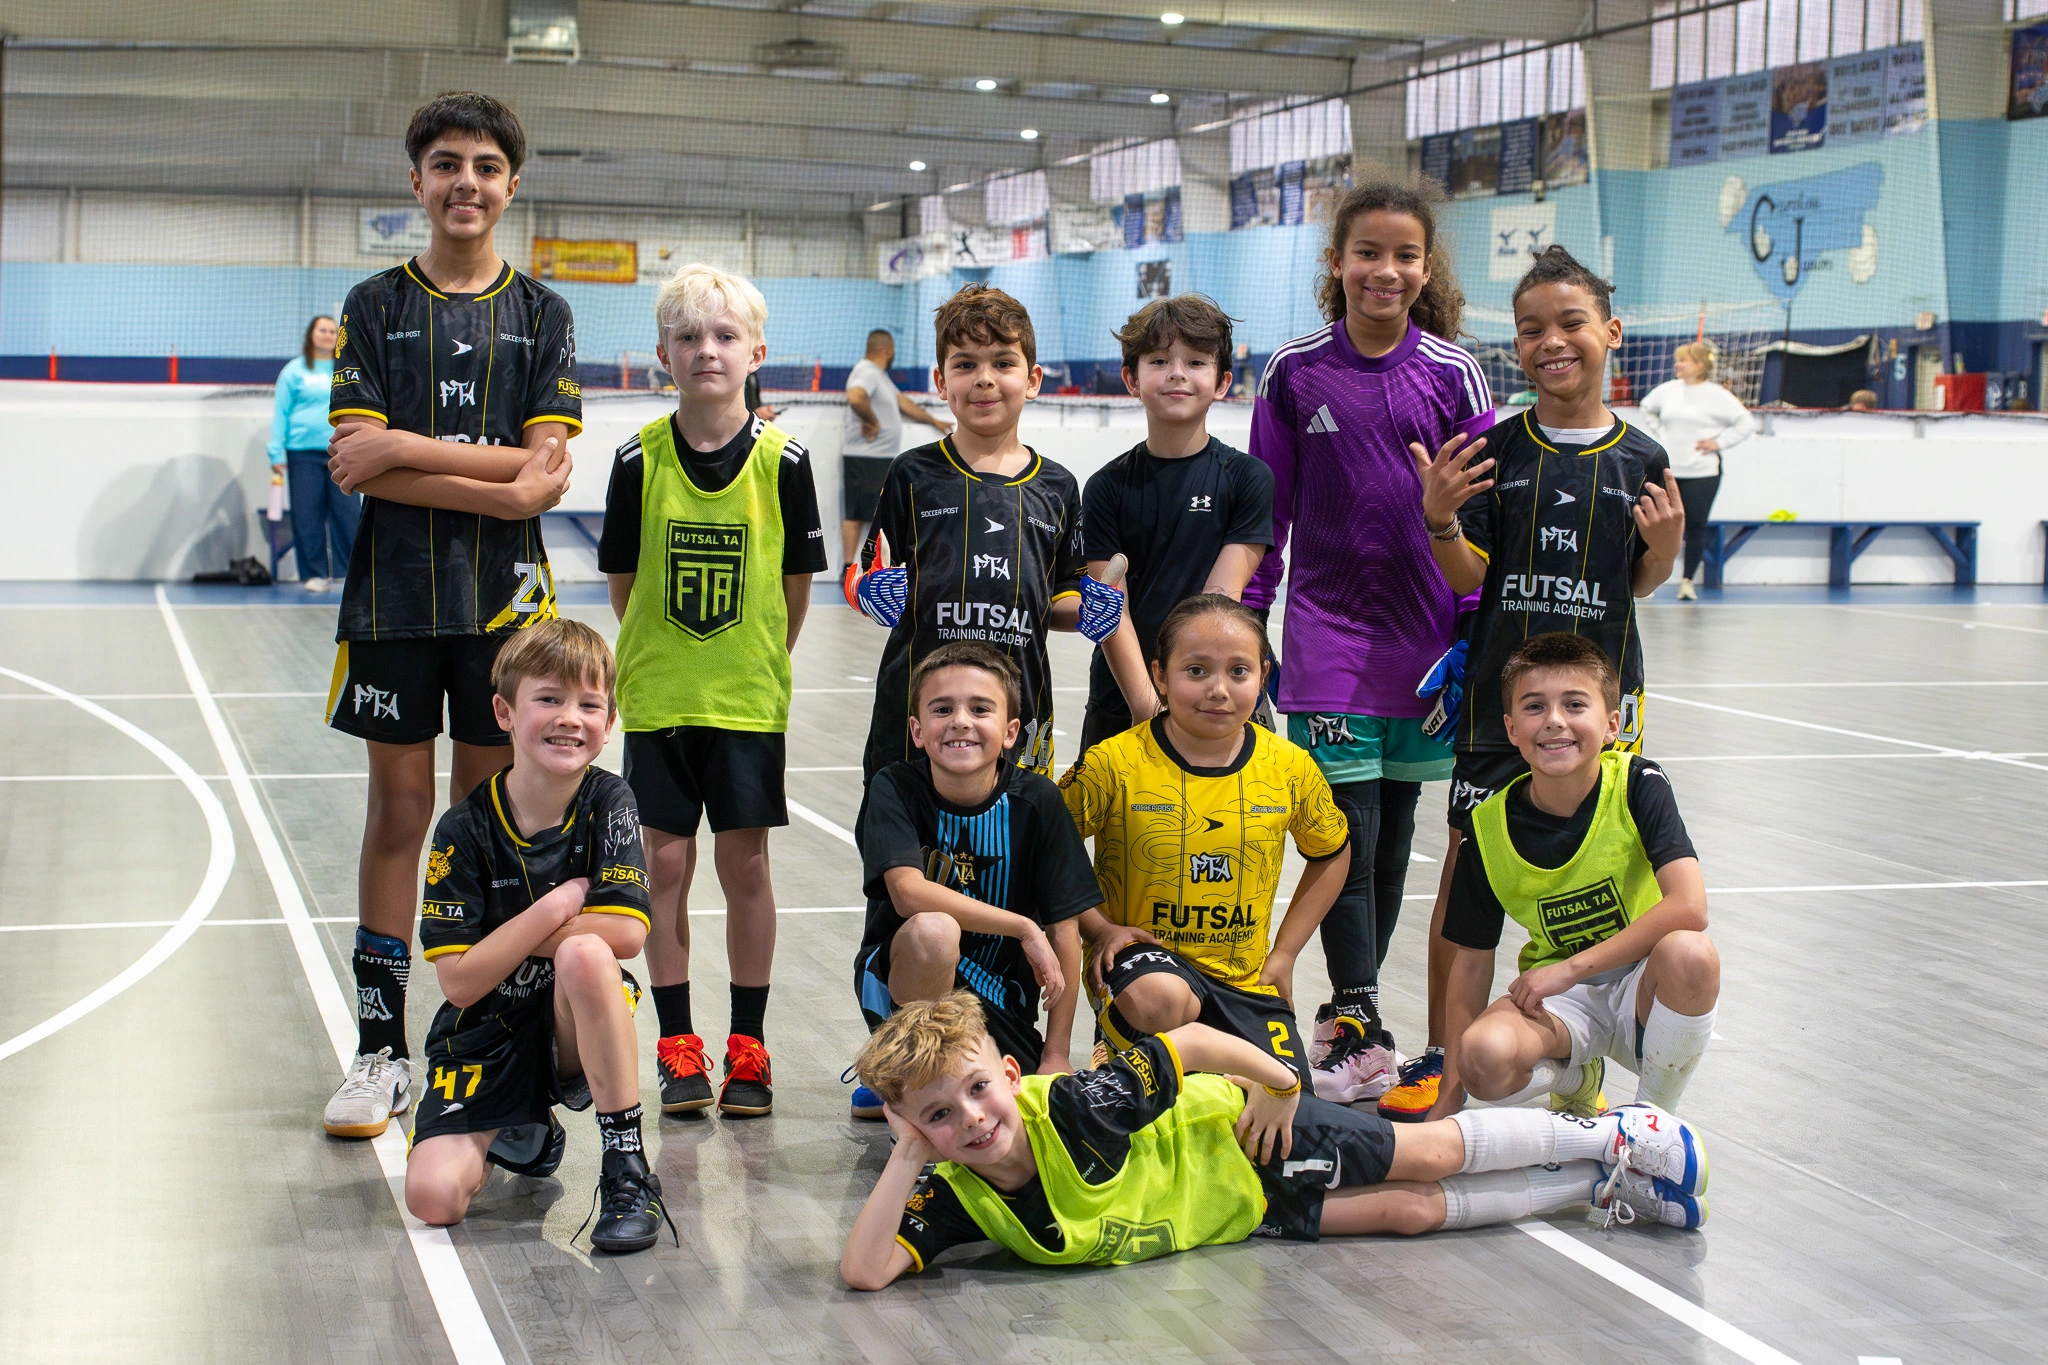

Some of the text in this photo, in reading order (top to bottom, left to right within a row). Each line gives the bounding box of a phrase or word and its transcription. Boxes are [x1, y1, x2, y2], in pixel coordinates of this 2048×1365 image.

[405, 330, 421, 338] POST
[500, 332, 523, 344] SOCCER
[345, 370, 360, 381] TA
[1514, 479, 1530, 488] POST
[1602, 486, 1625, 498] SOCCER
[920, 506, 959, 518] SOCCER POST
[674, 531, 739, 546] FUTSAL TA
[1501, 574, 1607, 607] FUTSAL
[1501, 600, 1606, 621] TRAINING ACADEMY
[936, 602, 1033, 635] FUTSAL
[937, 628, 986, 641] TRAINING
[1131, 804, 1175, 812] SOCCER POST
[1250, 806, 1273, 814] SOCCER
[446, 905, 464, 917] TA
[1545, 892, 1612, 920] FUTSAL TA
[1152, 902, 1257, 930] FUTSAL
[1151, 929, 1256, 944] TRAINING ACADEMY
[360, 954, 408, 967] FUTSAL
[1267, 1021, 1294, 1058] 2
[1128, 1050, 1156, 1097] FUTSAL
[432, 1064, 483, 1100] 47
[1082, 1162, 1097, 1179] POST
[909, 1217, 924, 1232] TA
